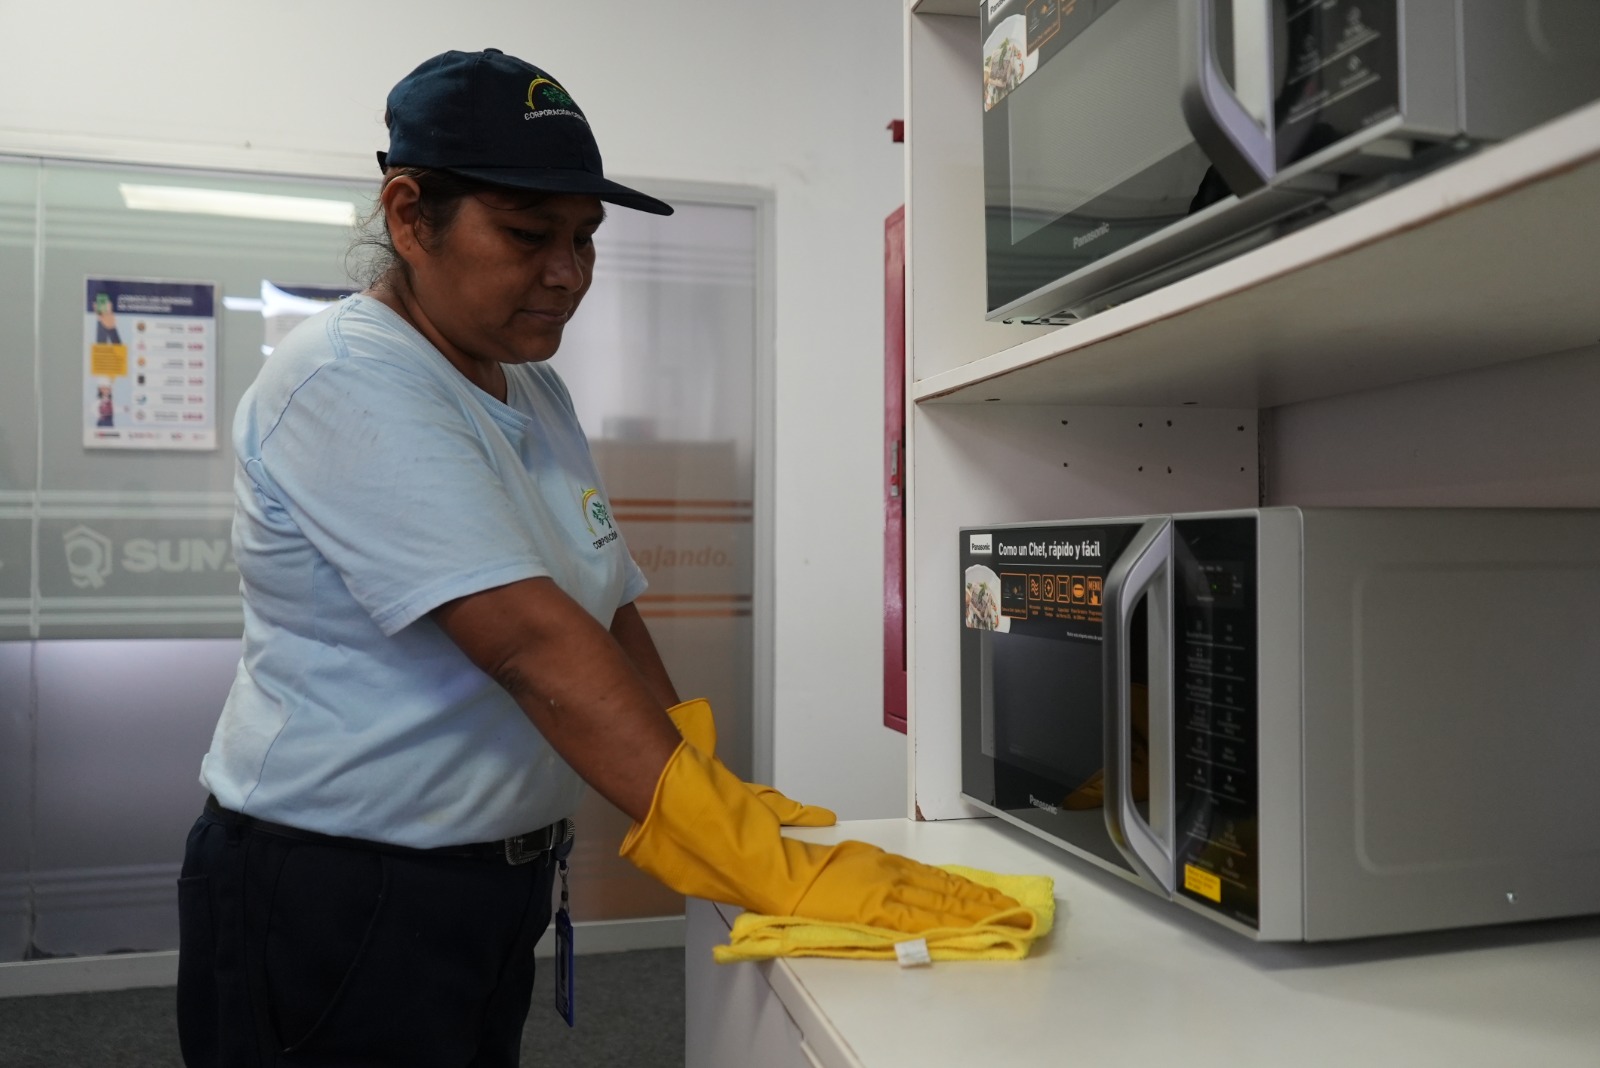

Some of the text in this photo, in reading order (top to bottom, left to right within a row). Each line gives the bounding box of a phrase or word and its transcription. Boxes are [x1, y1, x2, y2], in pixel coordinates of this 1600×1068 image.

[1073, 222, 1110, 249] Panasonic
[120, 537, 240, 573] SUN
[971, 542, 991, 551] Panasonic
[998, 540, 1101, 560] Como un Chef, rápido y fácil
[1029, 794, 1058, 815] Panasonic
